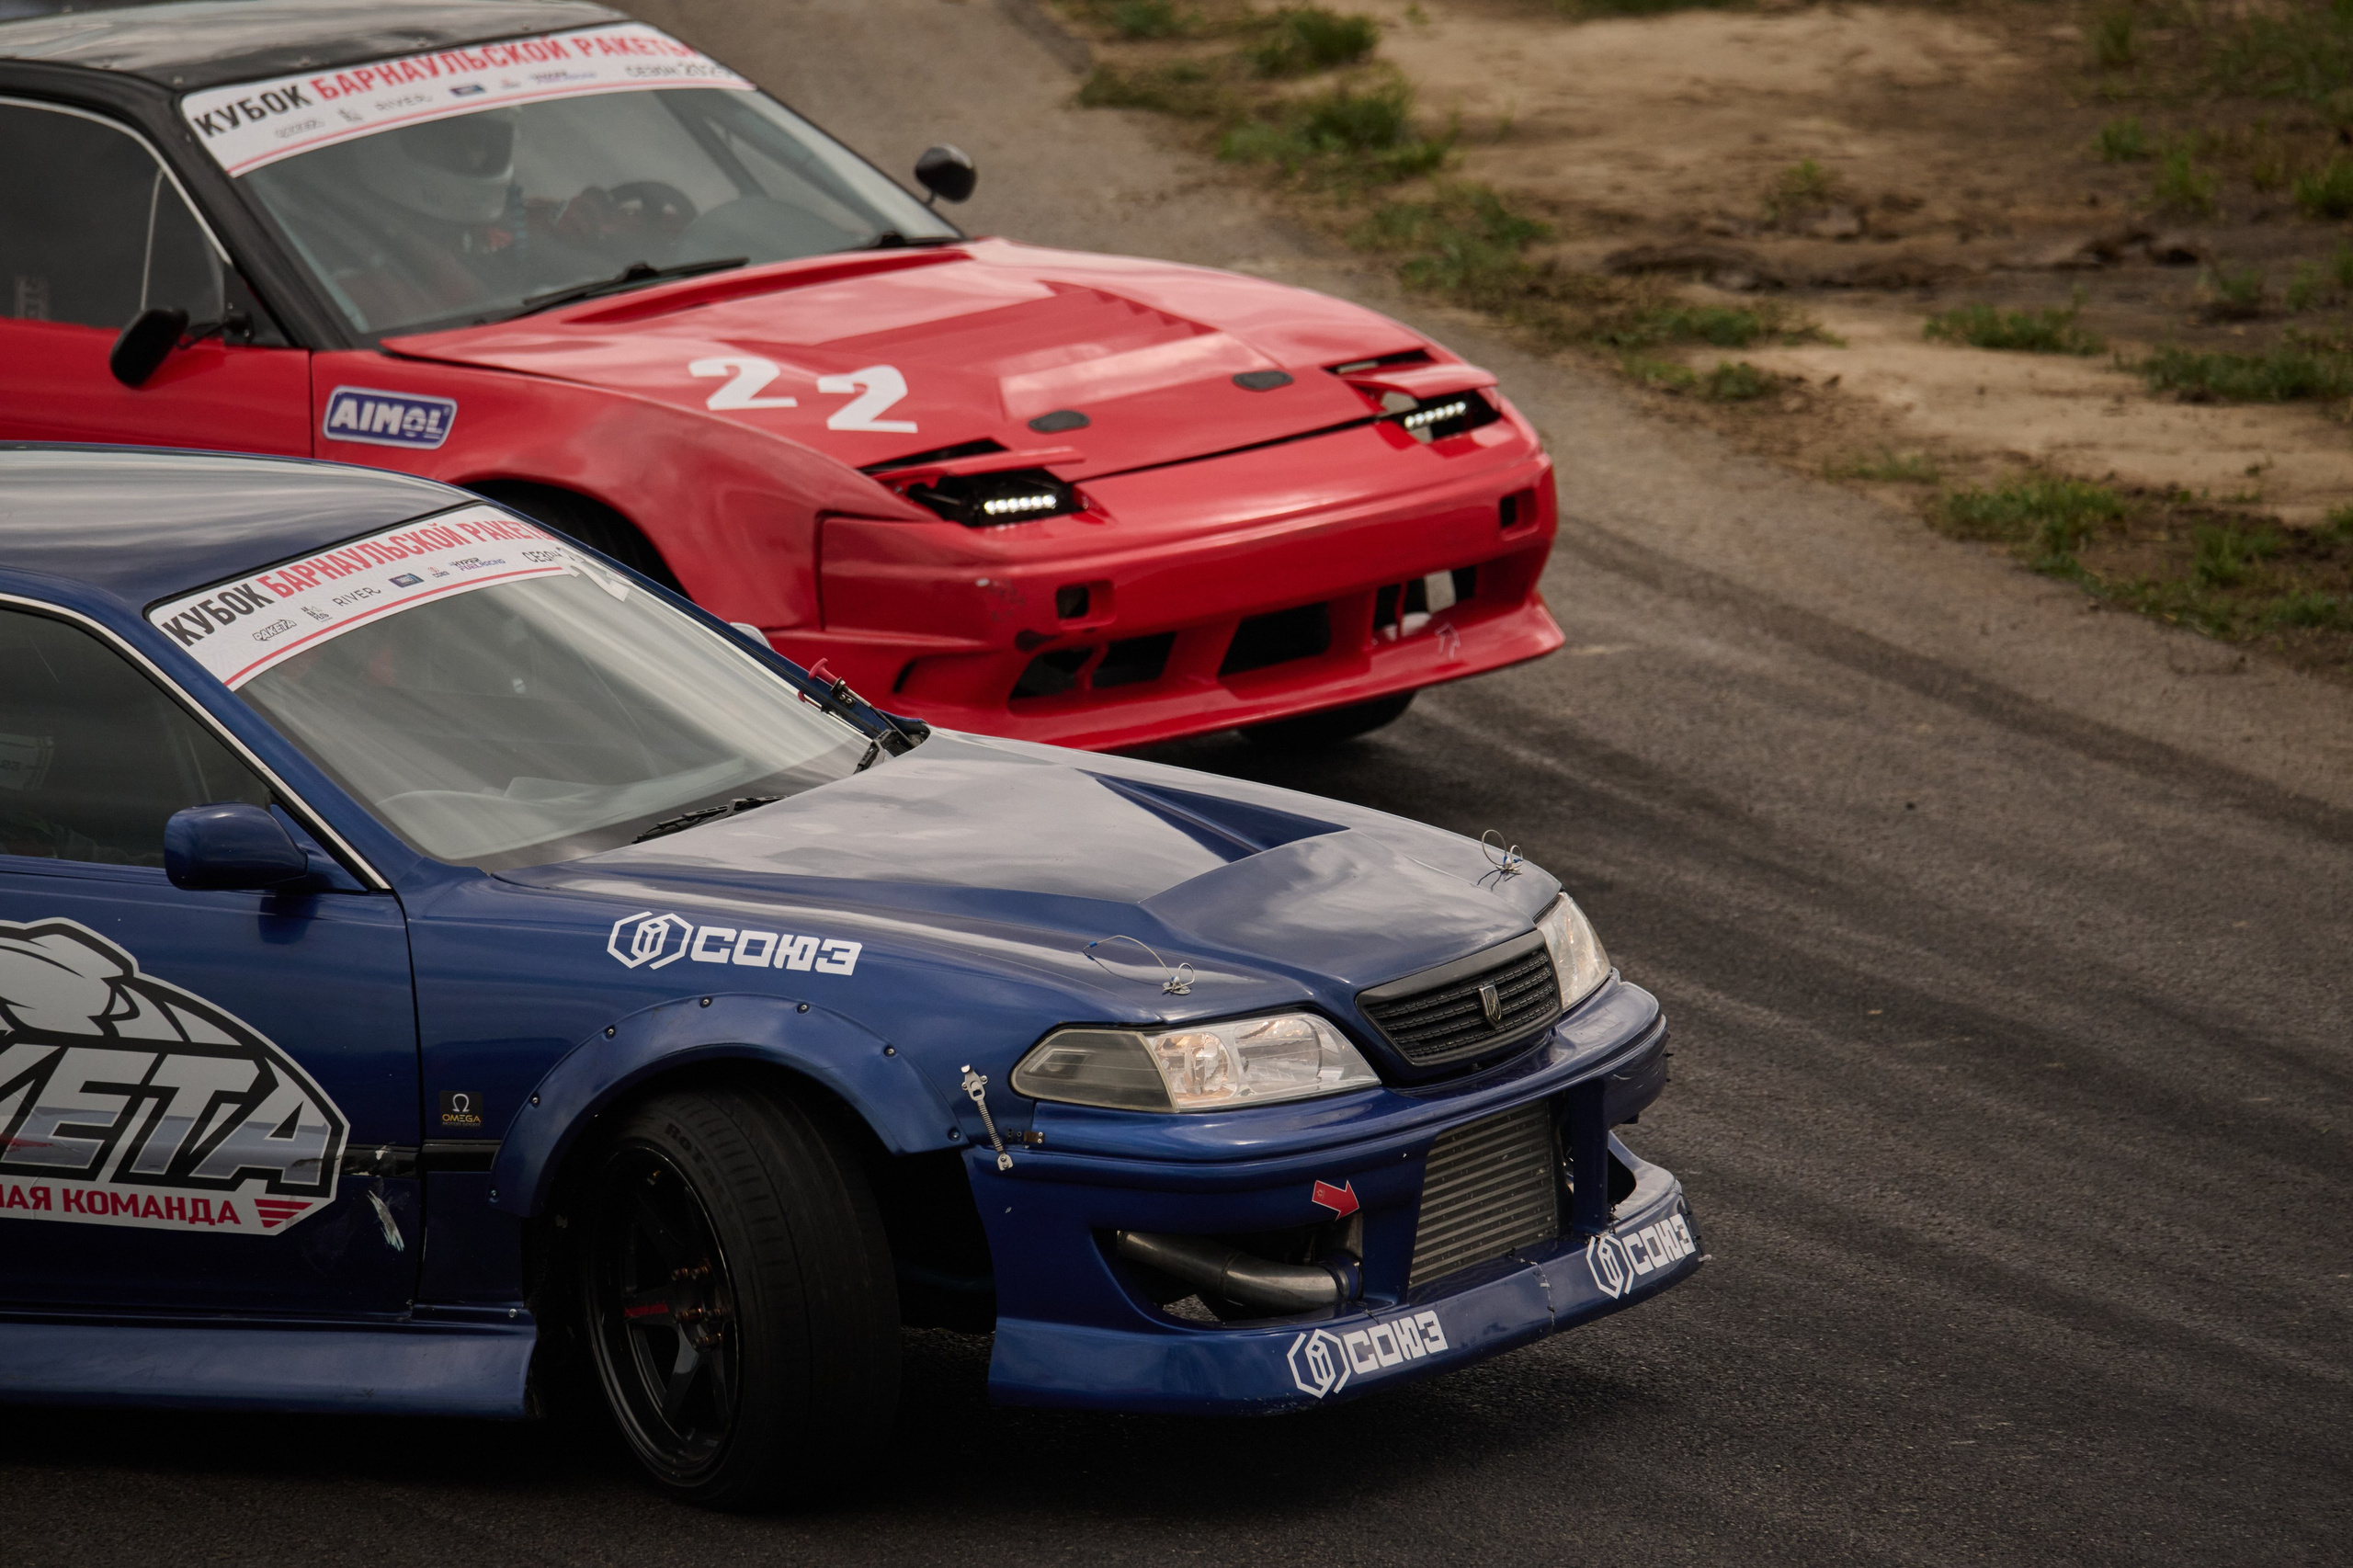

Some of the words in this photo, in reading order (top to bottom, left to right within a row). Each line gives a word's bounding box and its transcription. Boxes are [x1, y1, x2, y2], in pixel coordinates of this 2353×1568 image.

[193, 85, 314, 137] КУБОК
[309, 35, 571, 101] БАРНАУЛЬСКОЙ
[329, 397, 444, 440] AIMOL
[162, 583, 276, 647] КУБОК
[256, 522, 472, 598] БАРНАУЛЬСКОЙ
[332, 586, 381, 607] RIVER
[252, 619, 297, 642] РАКЕТА
[690, 926, 862, 976] СОЮЗ
[441, 1113, 482, 1123] OMEGA
[0, 1184, 52, 1211] АЯ
[63, 1188, 242, 1226] КОМАНДА
[1621, 1213, 1697, 1276] СОЮЗ
[1343, 1310, 1449, 1375] СОЮЗ
